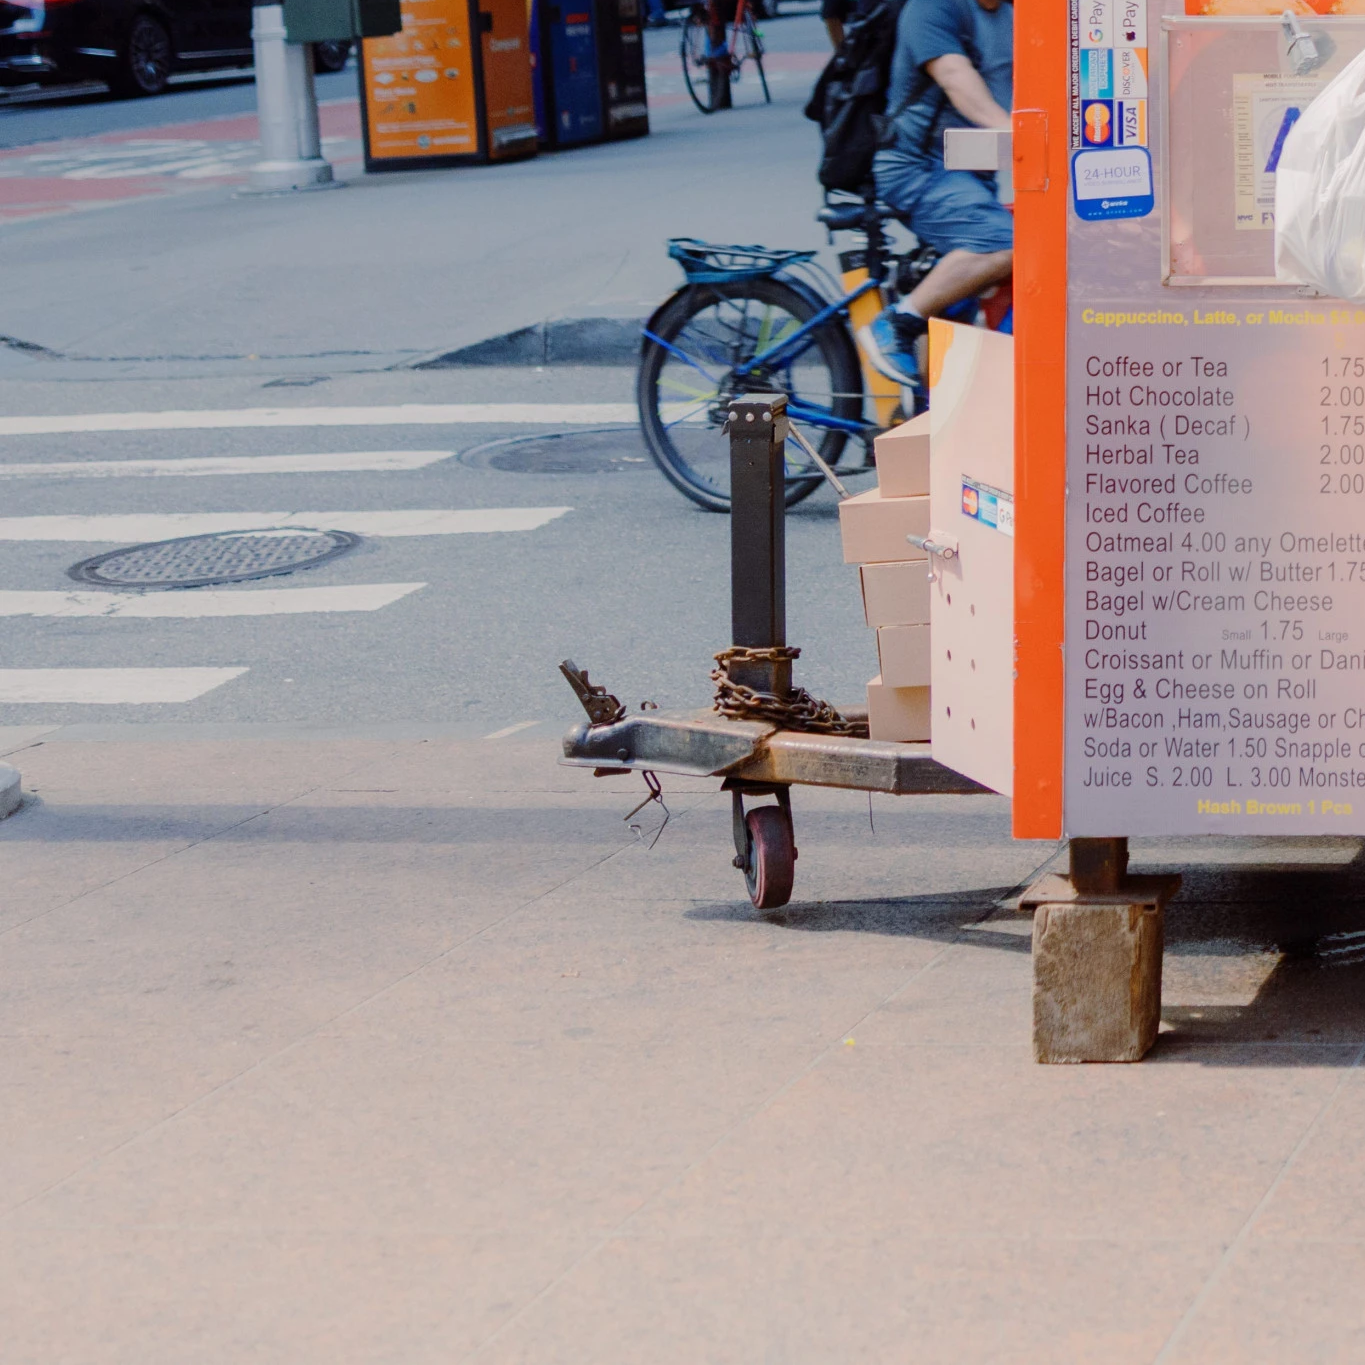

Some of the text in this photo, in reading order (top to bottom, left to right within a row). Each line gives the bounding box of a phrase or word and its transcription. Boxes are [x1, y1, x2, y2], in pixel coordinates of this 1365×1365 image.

[1089, 0, 1106, 25] Pay
[1123, 0, 1139, 28] Pay
[1123, 51, 1131, 95] DISCOVER
[1125, 106, 1137, 139] VISA
[1083, 165, 1141, 181] 24-HOUR
[1086, 356, 1156, 379] Coffee
[1162, 362, 1185, 379] or
[1190, 356, 1229, 379] Tea
[1322, 357, 1365, 379] 1.75
[1086, 385, 1123, 408] Hot
[1129, 385, 1236, 408] Chocolate
[1320, 386, 1365, 408] 2.00
[1086, 502, 1130, 525] Iced
[1137, 502, 1207, 525] Coffee
[1086, 531, 1174, 554] Oatmeal
[1181, 532, 1228, 554] 4.00
[1235, 537, 1273, 560] any
